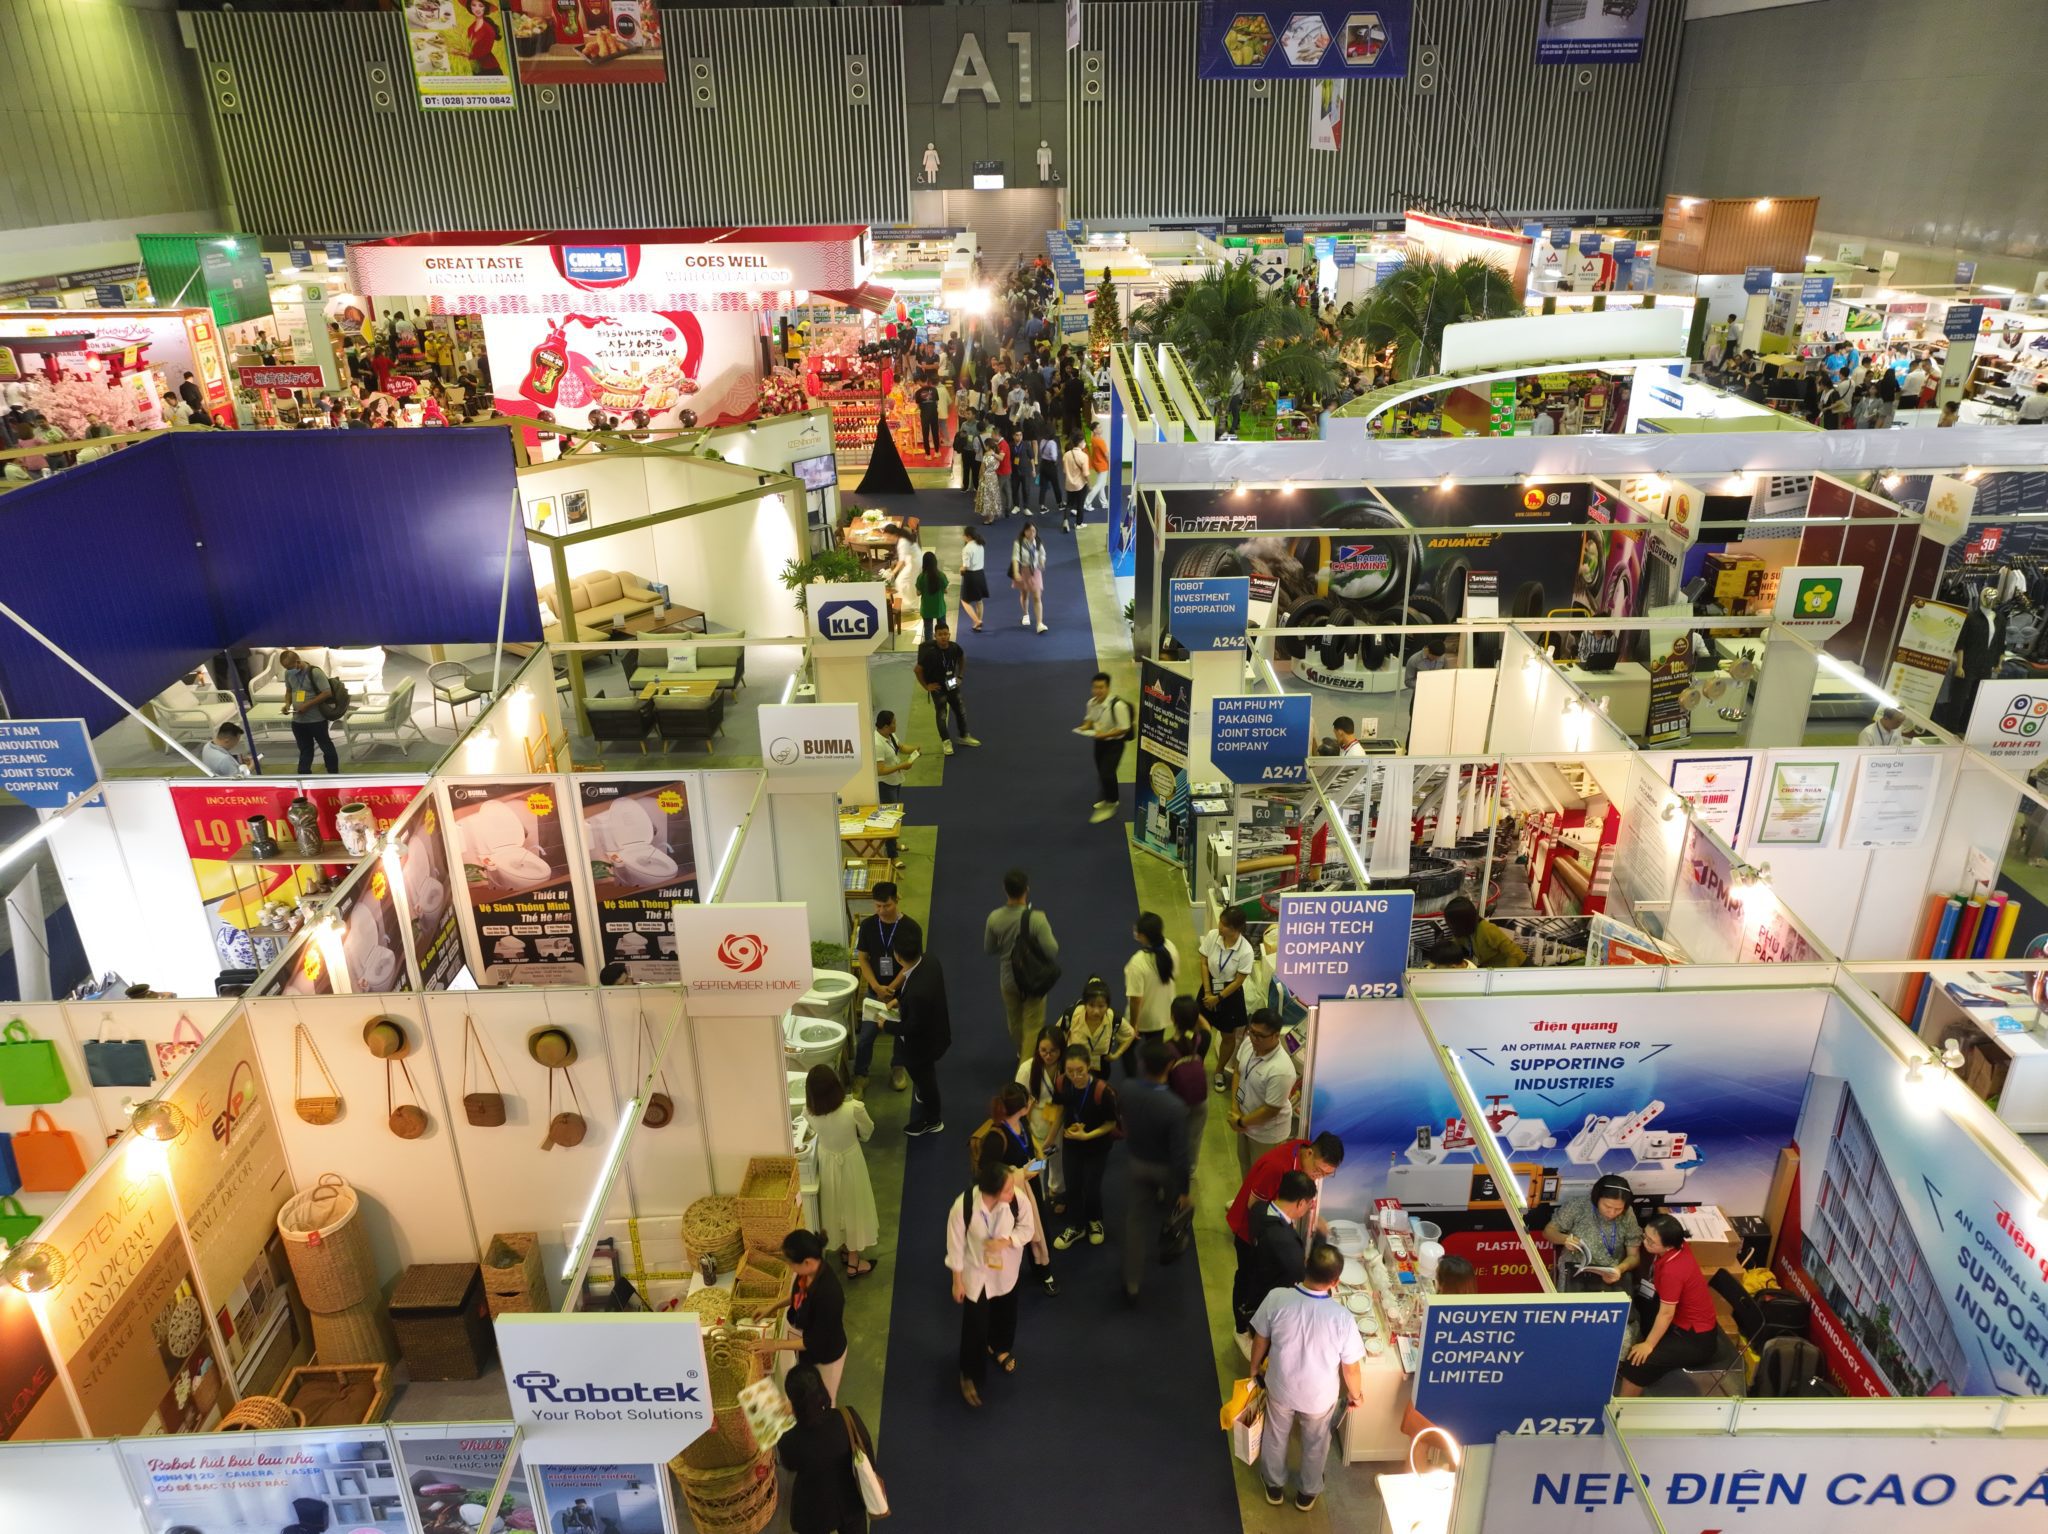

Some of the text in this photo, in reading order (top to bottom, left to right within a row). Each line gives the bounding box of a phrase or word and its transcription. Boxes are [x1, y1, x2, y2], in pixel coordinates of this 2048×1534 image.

[942, 32, 1032, 104] A1
[442, 96, 464, 106] (028)
[466, 96, 488, 104] 3770
[490, 96, 511, 104] 0842
[426, 257, 524, 270] GREAT TASTE
[686, 254, 768, 268] GOES WELL
[1428, 538, 1492, 548] ADVANCE
[1981, 538, 1996, 550] 30
[1357, 554, 1388, 562] RADIAL
[1332, 562, 1388, 571] CASUMINA
[1175, 582, 1203, 591] ROBOT
[1174, 593, 1230, 602] INVESTMENT
[1174, 604, 1235, 614] CORPORATION
[832, 618, 865, 634] KLC
[1213, 637, 1245, 648] A242
[1219, 700, 1285, 710] DAM PHU MY
[1218, 714, 1273, 724] PAKAGING
[13, 727, 40, 736] NAM
[1217, 728, 1287, 738] JOINT STOCK
[804, 739, 854, 754] BUMIA
[1217, 742, 1269, 751] COMPANY
[1, 768, 75, 778] JOINT STOCK
[1262, 766, 1303, 779] A247
[5, 782, 60, 791] COMPANY
[1256, 809, 1271, 819] 6.0
[194, 819, 231, 852] LỌ
[479, 902, 570, 914] Vệ Sinh Thông Minh
[604, 900, 669, 910] Vệ Sinh Thông
[1288, 900, 1388, 915] DIEN QUANG
[1287, 920, 1374, 935] HIGH TECH
[1285, 941, 1365, 955] COMPANY
[1284, 962, 1349, 974] LIMITED
[692, 980, 801, 990] SEPTEMBER HOME
[1345, 983, 1398, 999] A252
[1529, 1020, 1618, 1034] điện quang
[1501, 1041, 1640, 1052] AN OPTIMAL PARTNER FOR
[1510, 1057, 1625, 1071] SUPPORTING
[1514, 1077, 1615, 1091] INDUSTRIES
[1954, 1209, 2028, 1295] AN OPTIMAL
[1438, 1310, 1622, 1324] NGUYEN TIEN PHAT
[1781, 1256, 1811, 1302] MODERN
[1810, 1300, 1861, 1374] TECHNOLOGY
[1434, 1331, 1515, 1344] PLASTIC
[1431, 1351, 1524, 1364] COMPANY
[1429, 1370, 1504, 1383] LIMITED
[532, 1409, 703, 1421] Your Robot Solutions
[1514, 1418, 1595, 1434] A257
[226, 1470, 274, 1479] CAMERA
[285, 1467, 321, 1476] LASER
[1666, 1469, 1808, 1512] ĐIỆN
[1826, 1473, 1956, 1507] CAO
